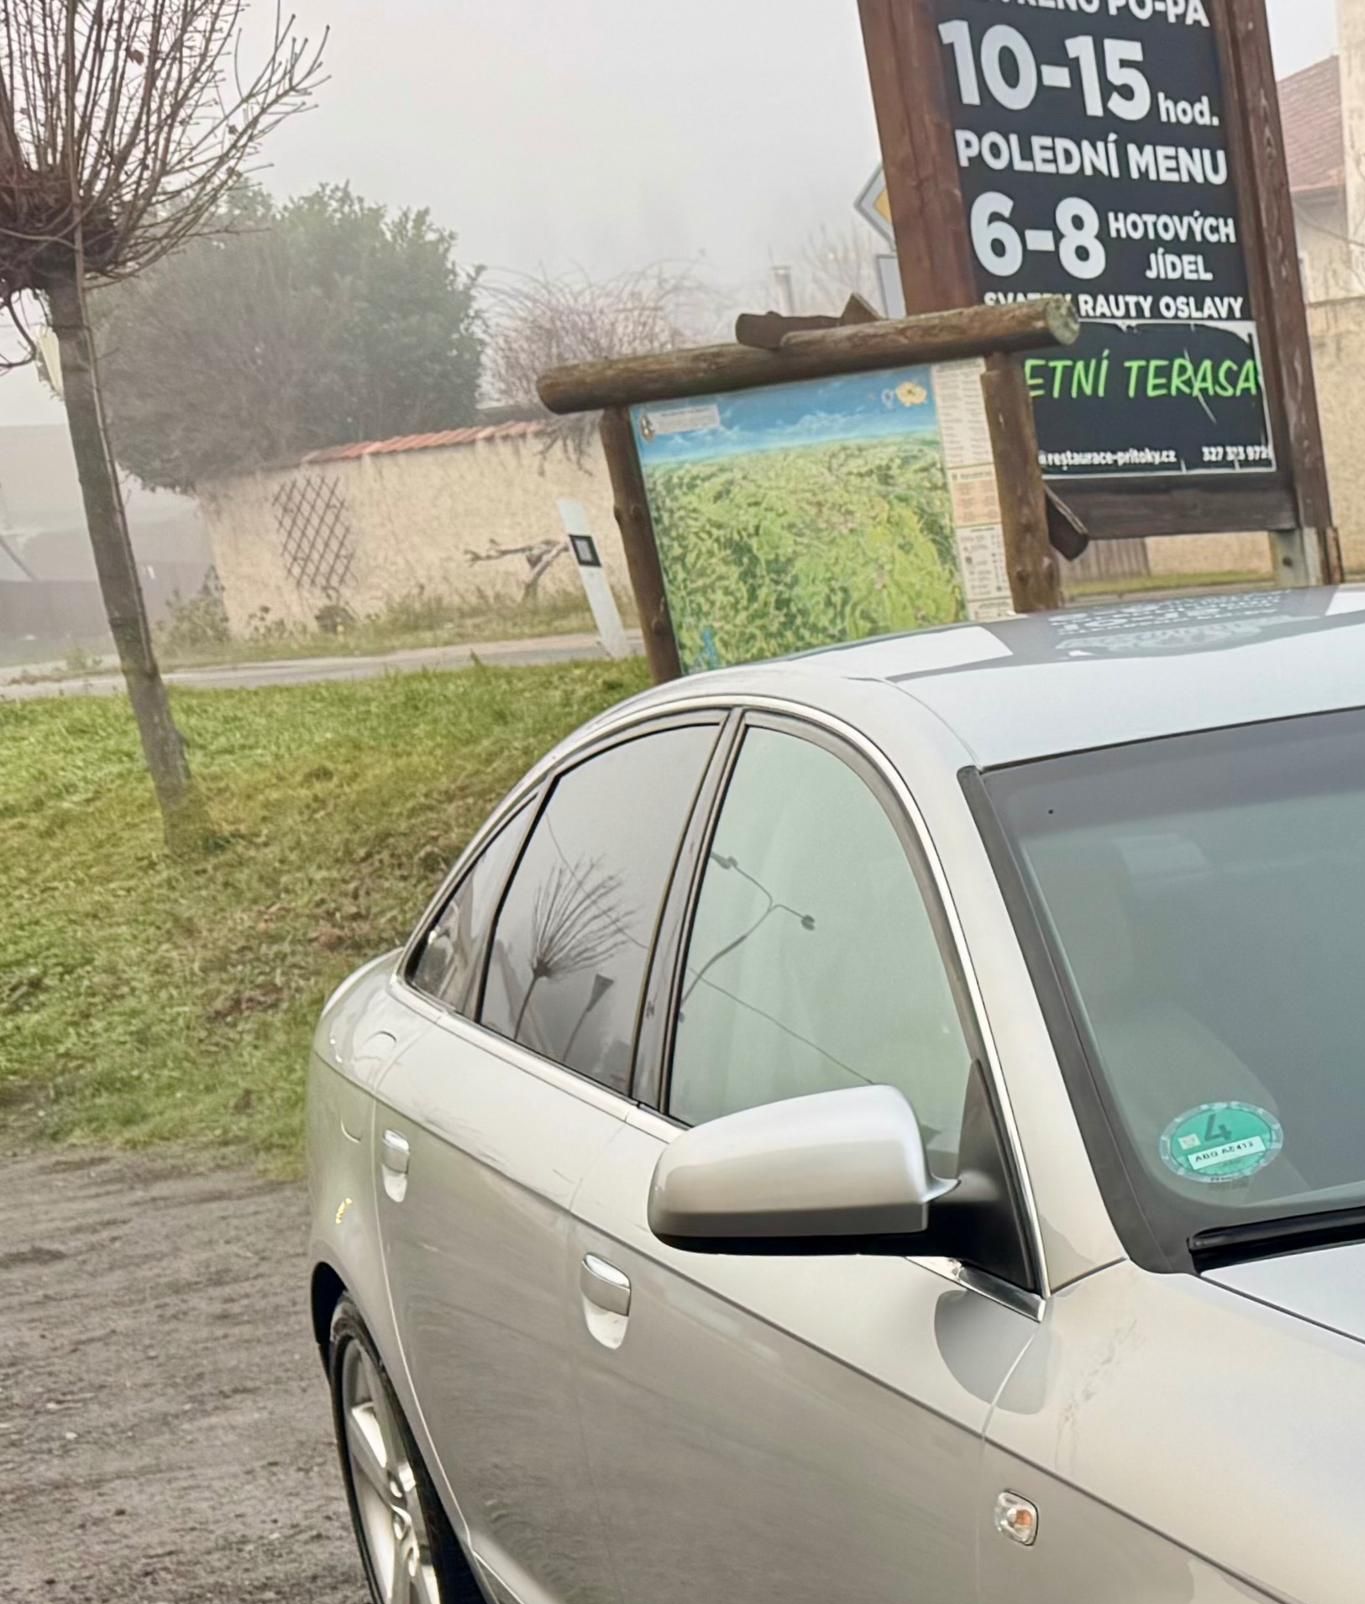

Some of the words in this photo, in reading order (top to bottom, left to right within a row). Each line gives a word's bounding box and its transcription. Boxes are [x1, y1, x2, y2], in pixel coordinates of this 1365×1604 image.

[938, 20, 1151, 120] 10-15
[1158, 93, 1220, 126] hod.
[955, 129, 1120, 178] POLEDNÍ
[1126, 143, 1228, 185] MENU
[970, 191, 1106, 280] 6-8
[1108, 210, 1236, 243] HOTOVÝCH
[1145, 247, 1213, 281] JÍDEL
[1078, 293, 1152, 317] RAUTY
[1159, 295, 1244, 319] OSLAVY
[1024, 348, 1110, 399] ETNÍ
[1124, 358, 1258, 399] TERASA
[1205, 1113, 1231, 1141] 4
